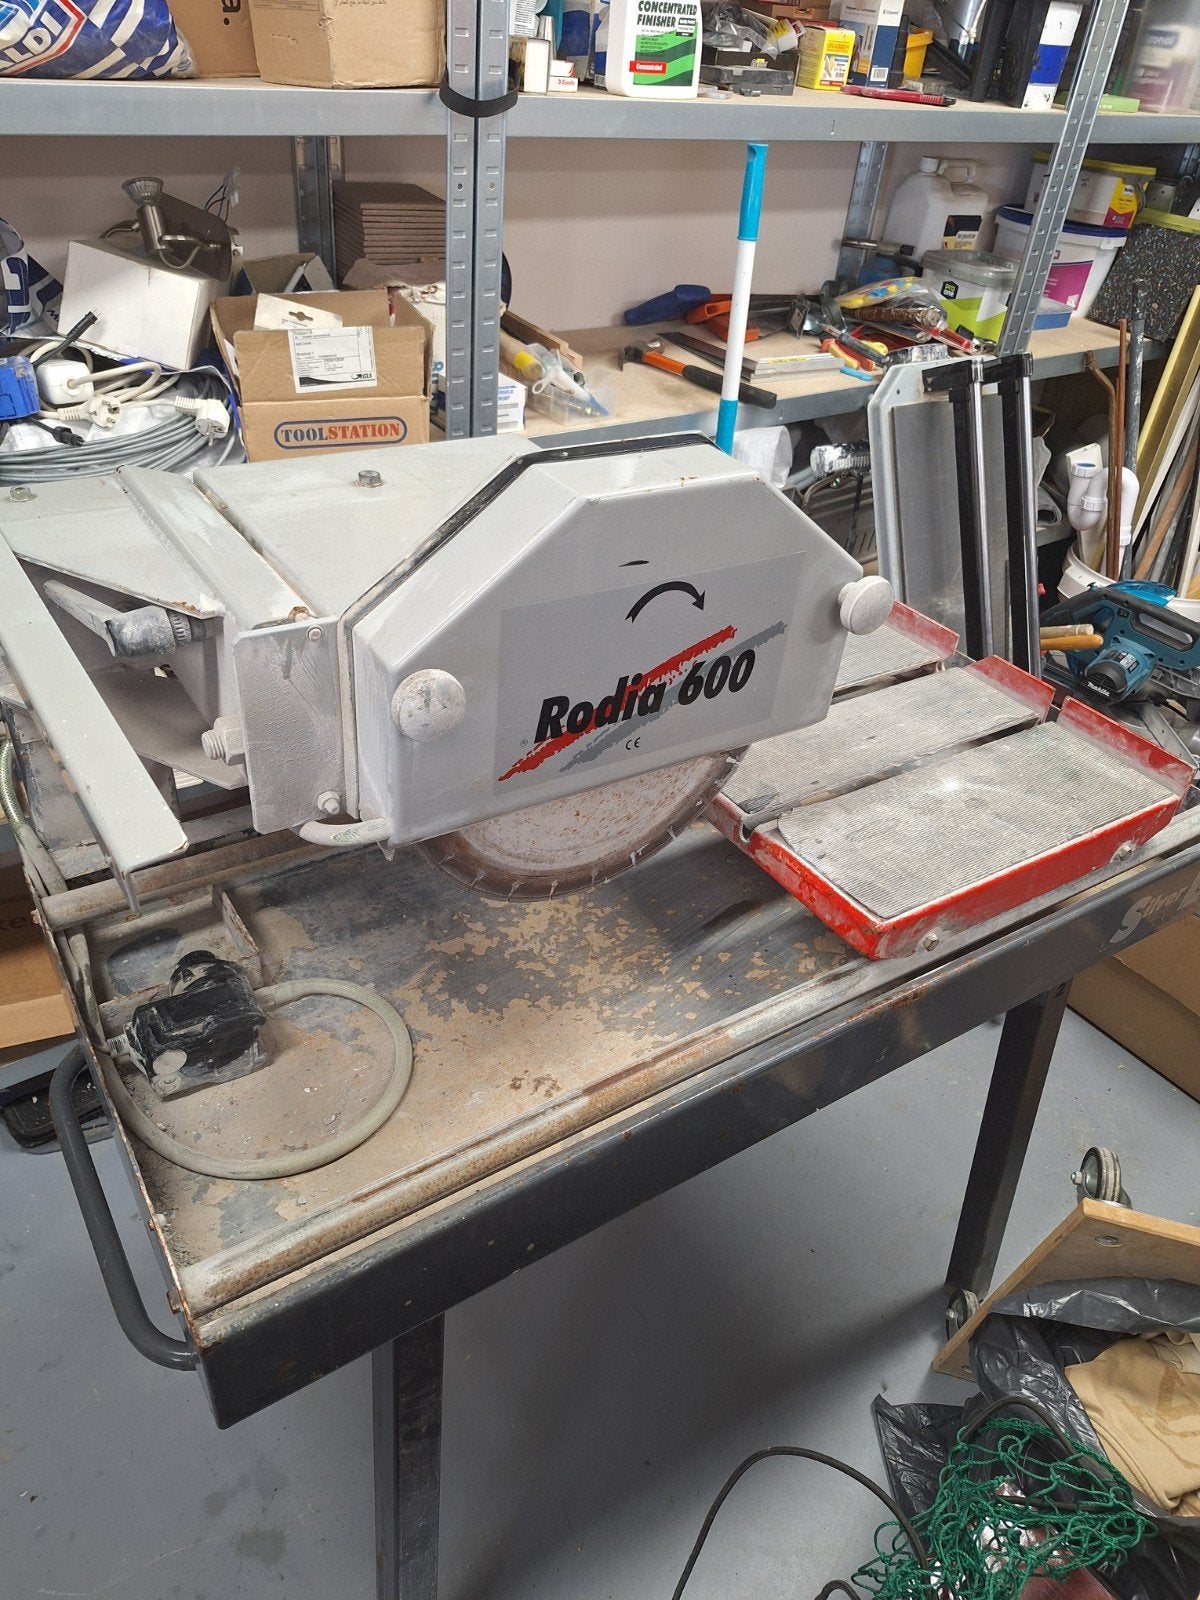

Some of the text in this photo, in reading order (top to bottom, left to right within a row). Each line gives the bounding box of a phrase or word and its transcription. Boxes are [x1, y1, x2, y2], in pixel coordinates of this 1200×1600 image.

[637, 1, 698, 15] CONCENTRATED
[637, 14, 676, 27] FINISHER
[281, 423, 400, 443] TOOLSTATION
[533, 649, 756, 744] Rodia 600
[1087, 681, 1111, 697] Makita
[625, 736, 641, 750] CE
